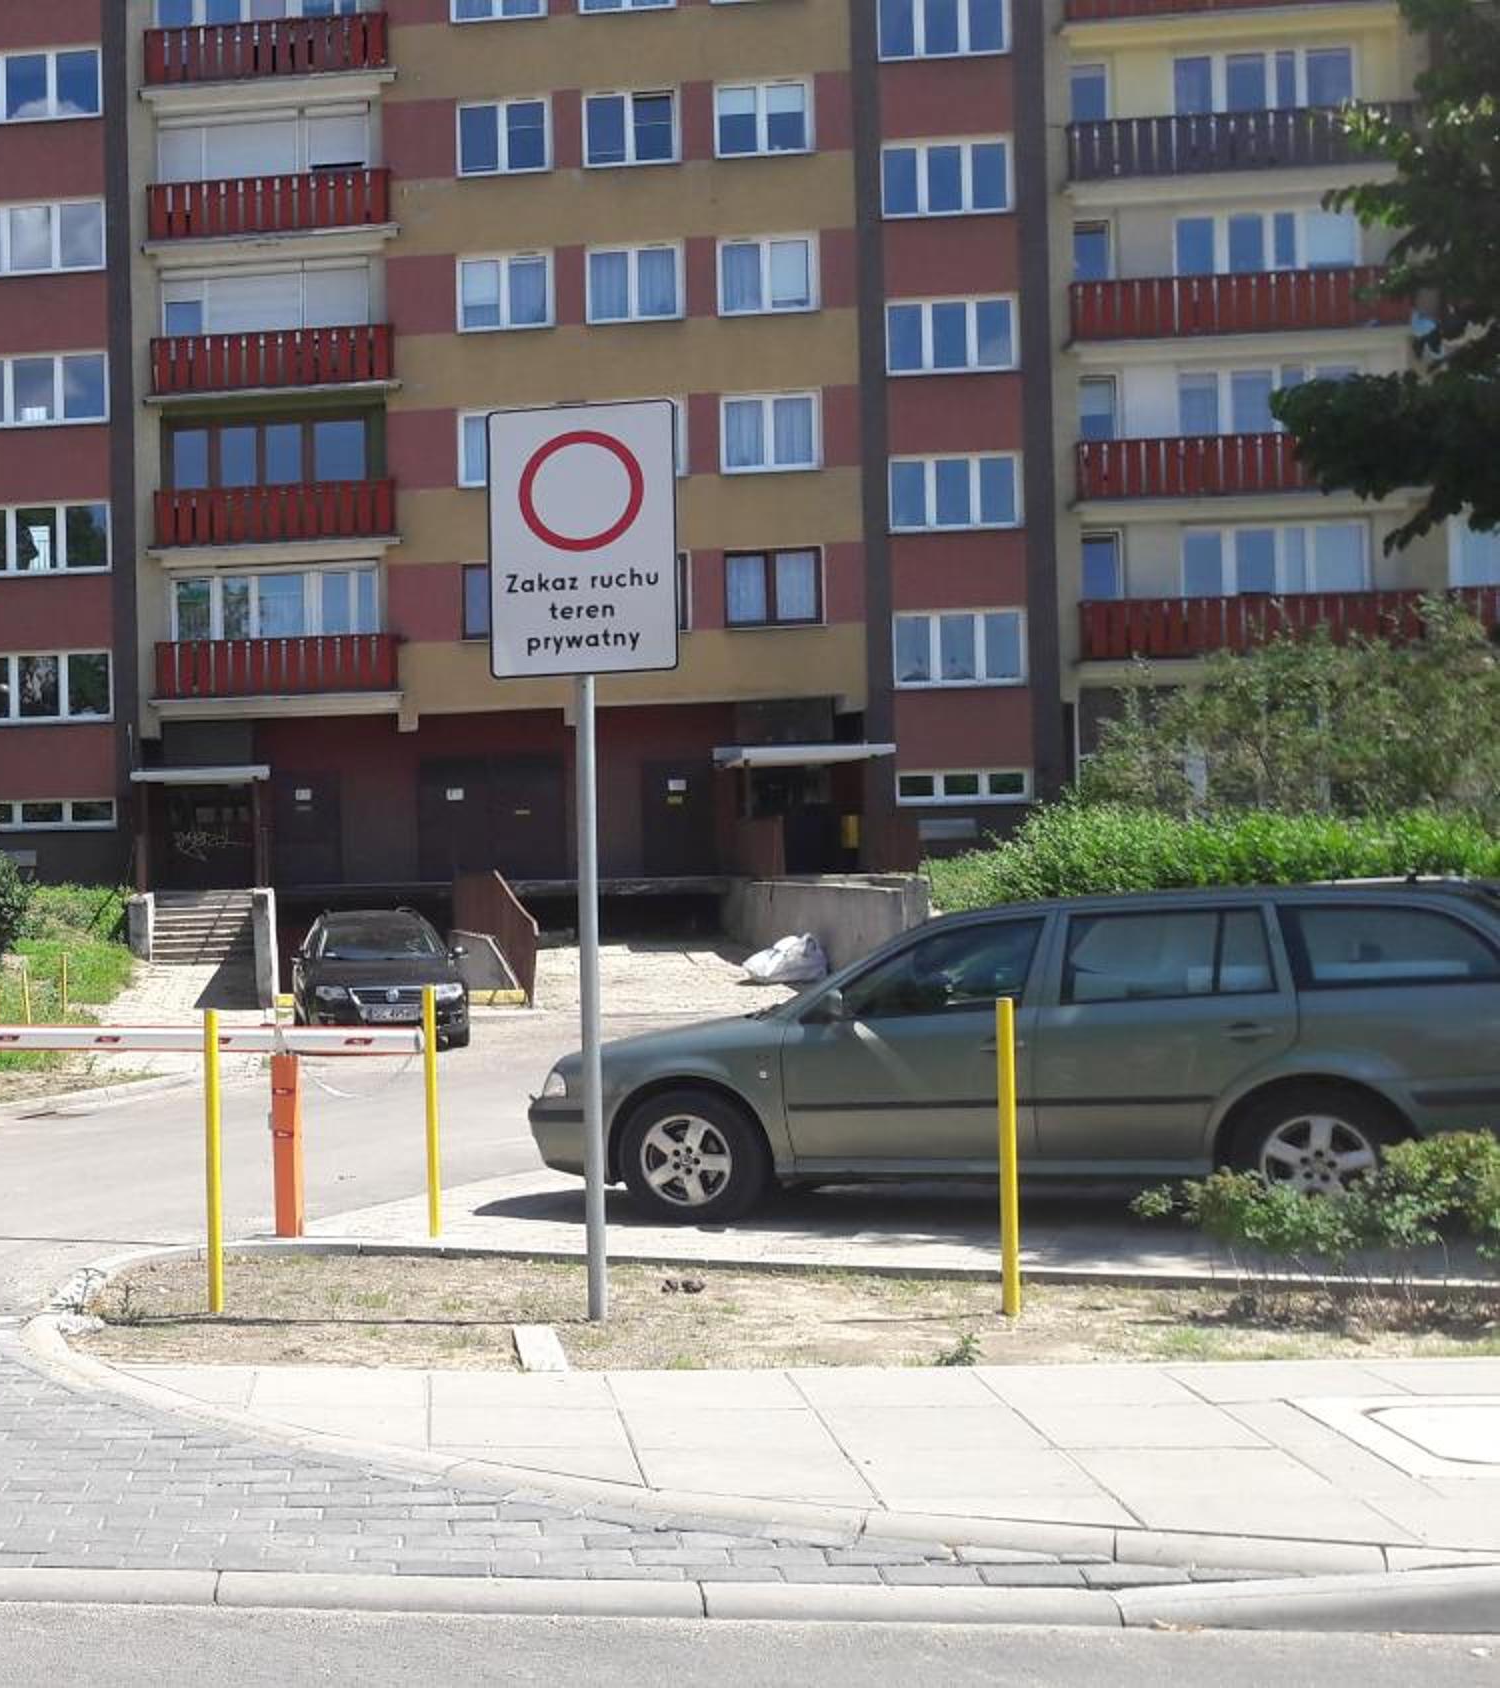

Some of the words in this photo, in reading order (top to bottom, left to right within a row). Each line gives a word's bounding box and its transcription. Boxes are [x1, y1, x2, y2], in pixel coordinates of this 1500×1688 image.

[505, 572, 579, 594] Zakaz
[590, 567, 659, 589] ruchu
[549, 602, 615, 620] teren
[526, 628, 641, 657] prywatny
